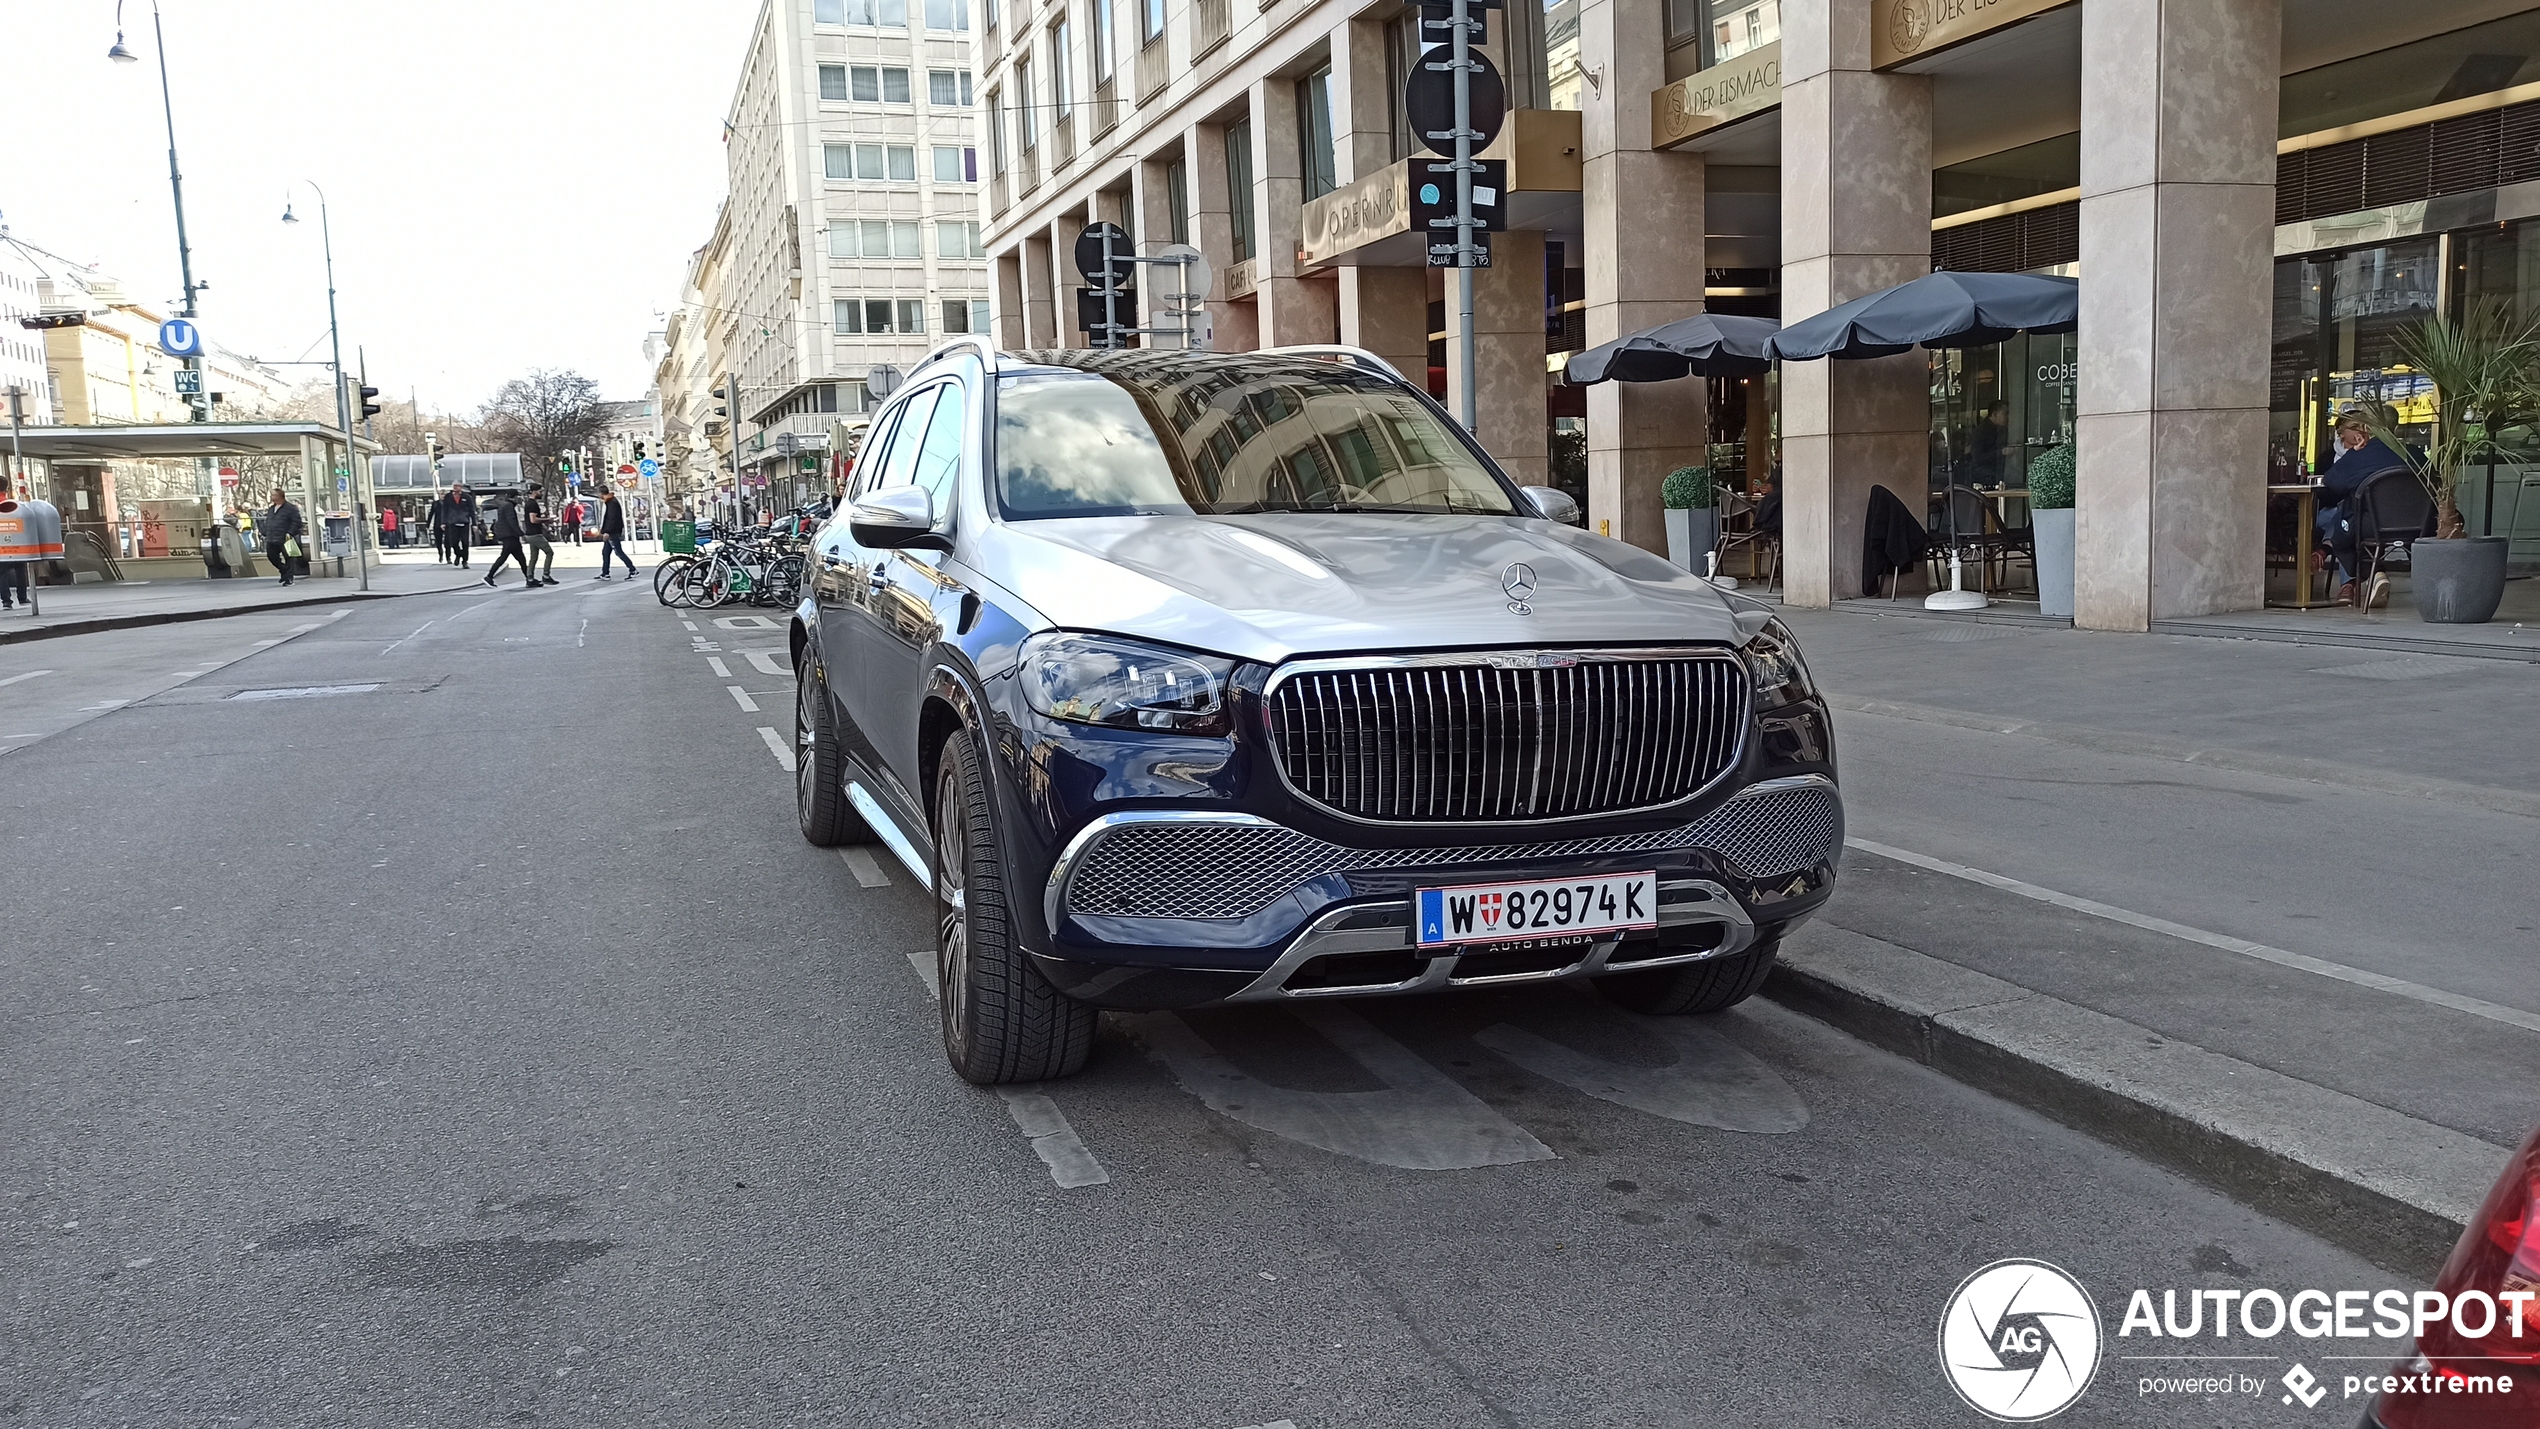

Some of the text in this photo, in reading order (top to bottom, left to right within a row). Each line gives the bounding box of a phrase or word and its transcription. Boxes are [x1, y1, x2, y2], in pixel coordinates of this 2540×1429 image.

[1694, 86, 1714, 115] DER
[166, 325, 194, 351] U
[176, 371, 198, 383] WC
[2037, 363, 2077, 381] COBE
[1450, 881, 1644, 933] W 82974 K
[1428, 923, 1437, 934] A
[1490, 935, 1594, 952] AUTO BENDA
